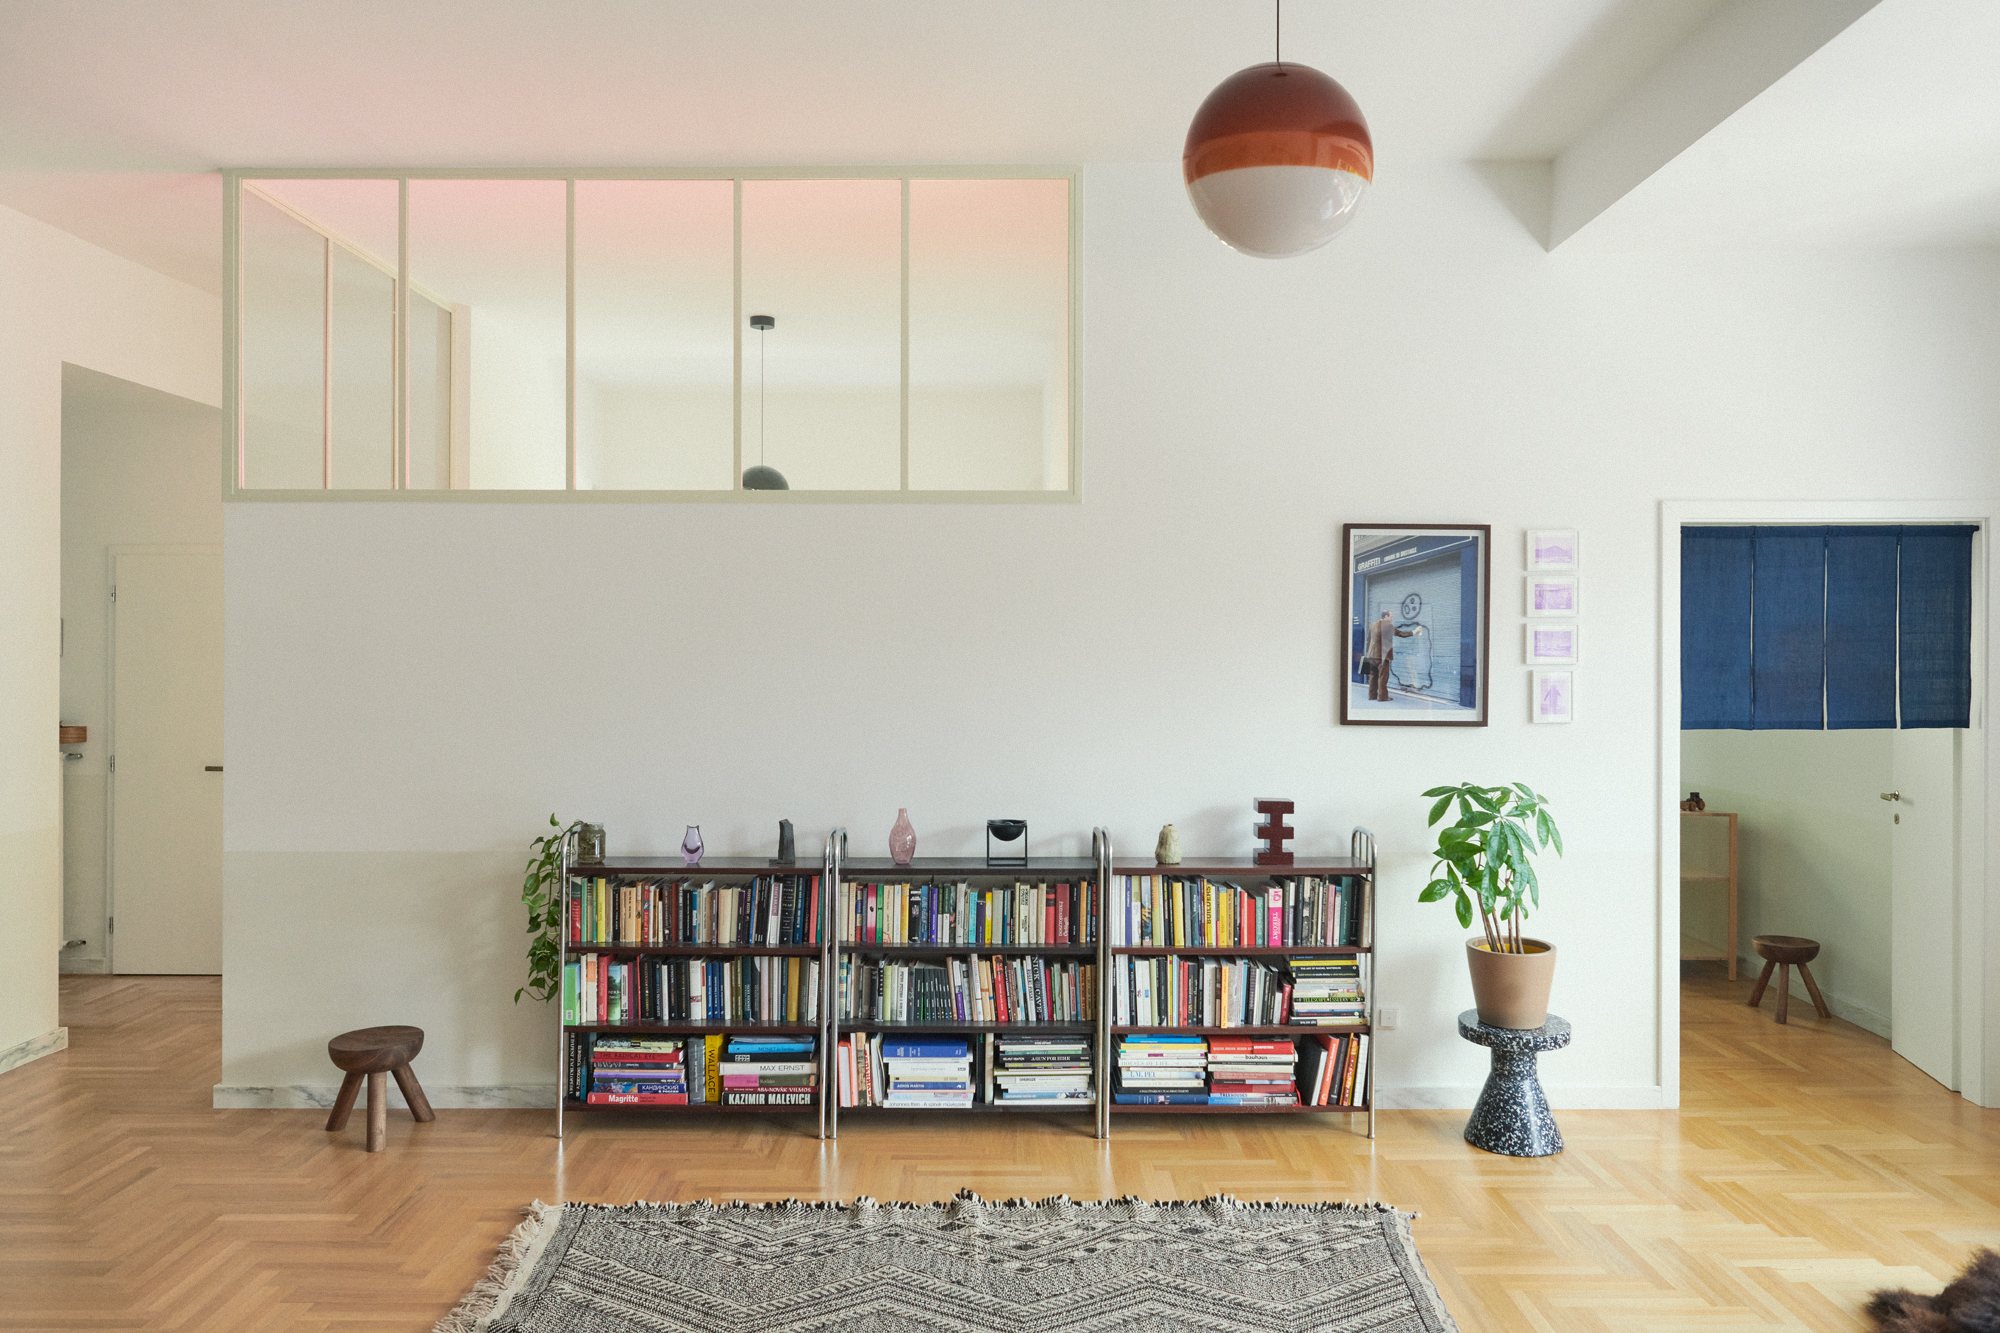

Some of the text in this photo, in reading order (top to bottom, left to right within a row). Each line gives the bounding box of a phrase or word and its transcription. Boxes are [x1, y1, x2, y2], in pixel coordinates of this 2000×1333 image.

[1031, 956, 1040, 981] NICK
[1035, 988, 1043, 1013] CAVE
[708, 1049, 716, 1093] WALLACE
[608, 1095, 639, 1104] Magritte
[728, 1093, 811, 1105] KAZIMIR MALEVICH
